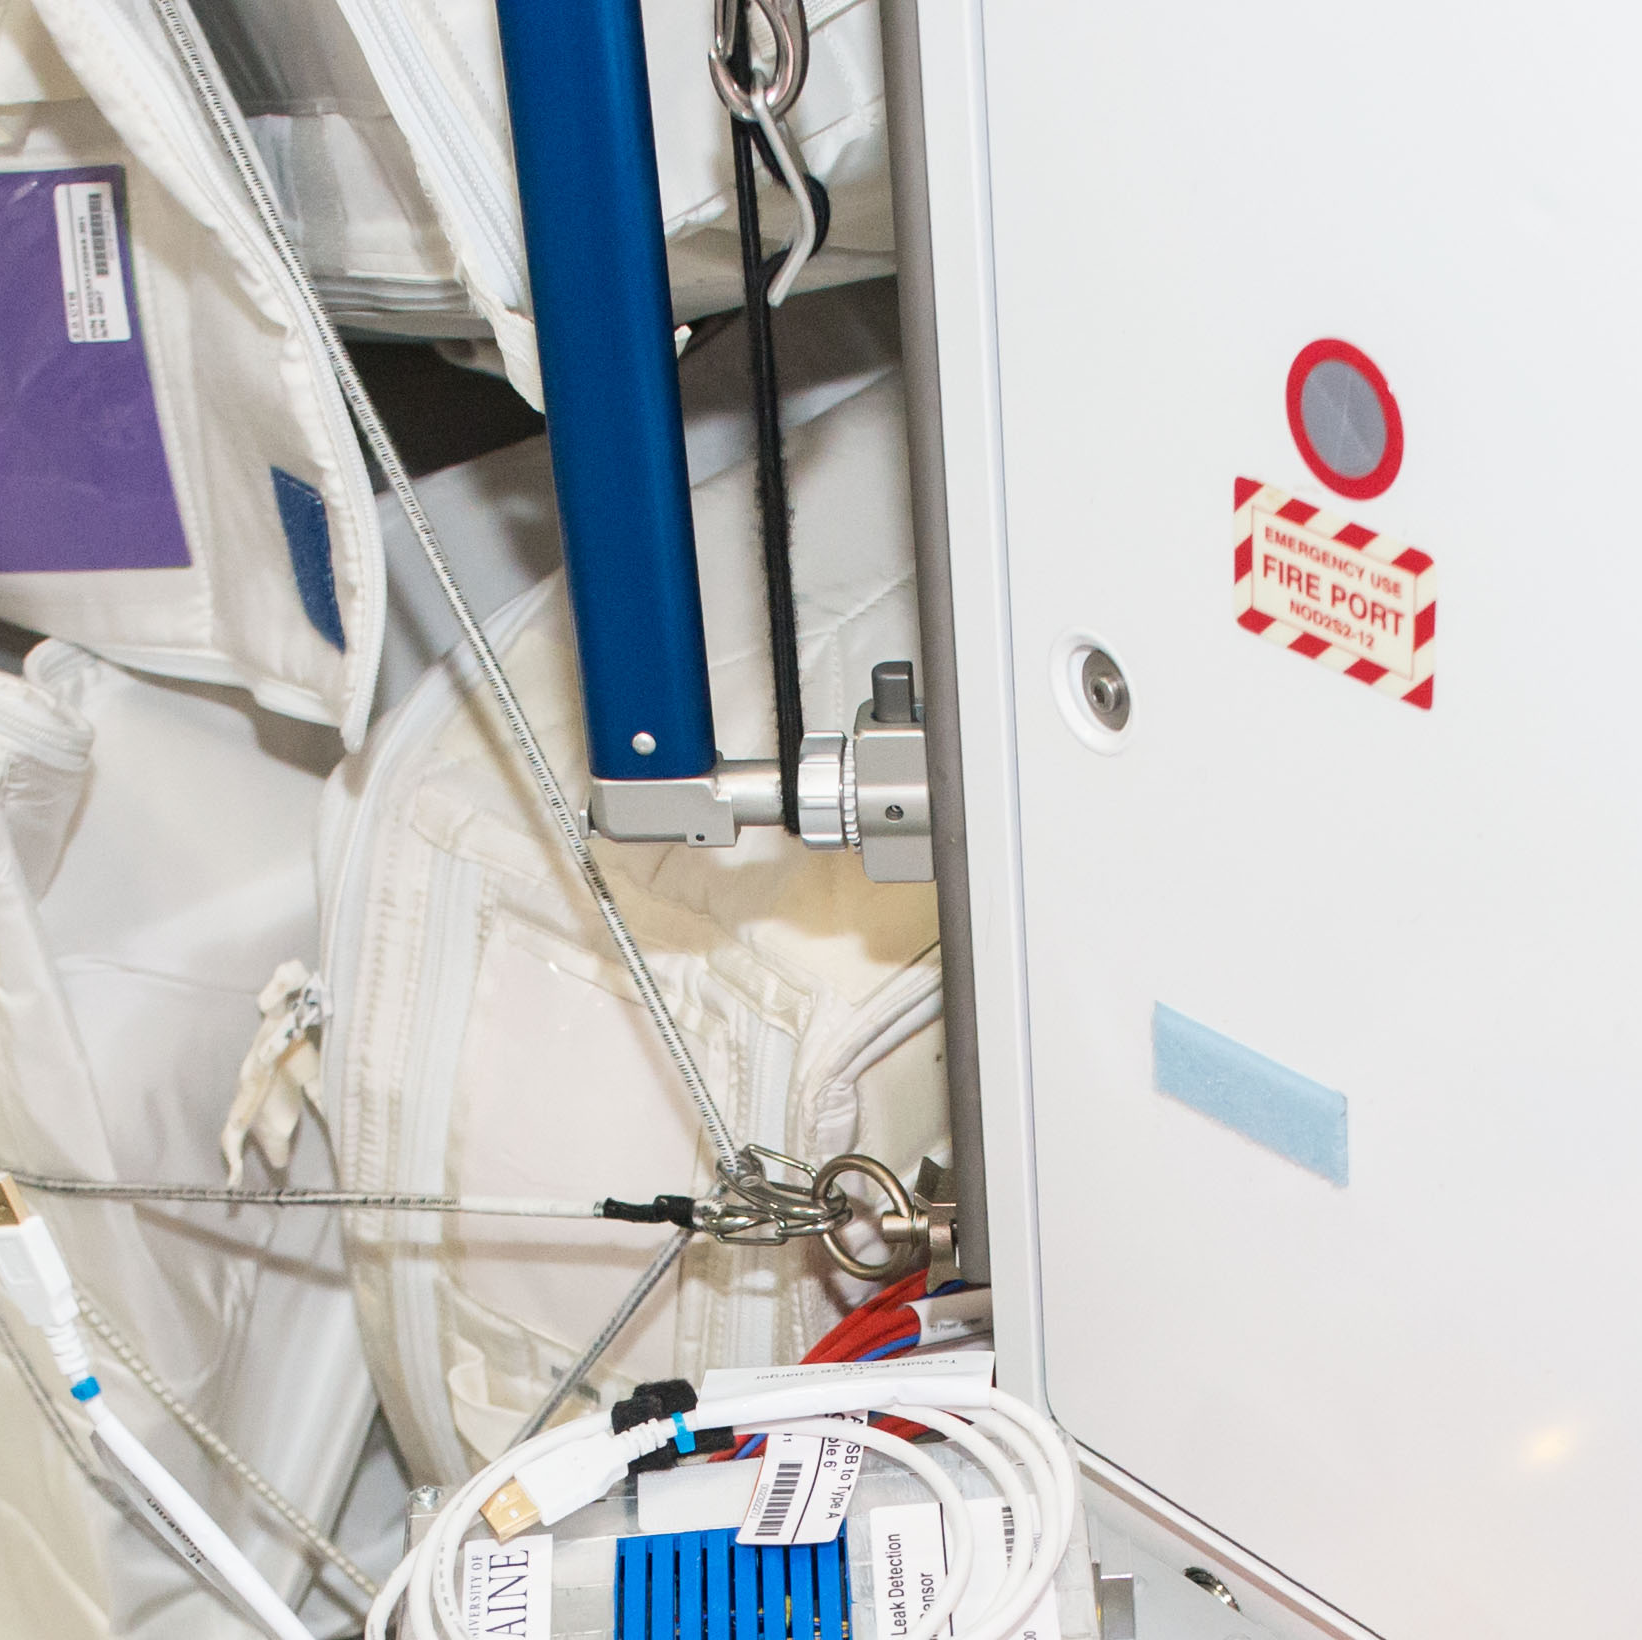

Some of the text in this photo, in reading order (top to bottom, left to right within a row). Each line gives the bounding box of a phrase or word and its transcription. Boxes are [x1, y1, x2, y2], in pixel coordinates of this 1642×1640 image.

[1264, 525, 1402, 599] EMERGENCY USE
[1262, 553, 1405, 637] FIRE PORT
[1289, 599, 1375, 650] NOD2S2-12
[844, 1440, 861, 1465] SB
[839, 1469, 855, 1481] to
[830, 1483, 852, 1509] Type
[825, 1511, 841, 1520] A
[471, 1554, 483, 1571] OF
[884, 1532, 908, 1636] Leak Detection
[919, 1572, 936, 1620] ensor
